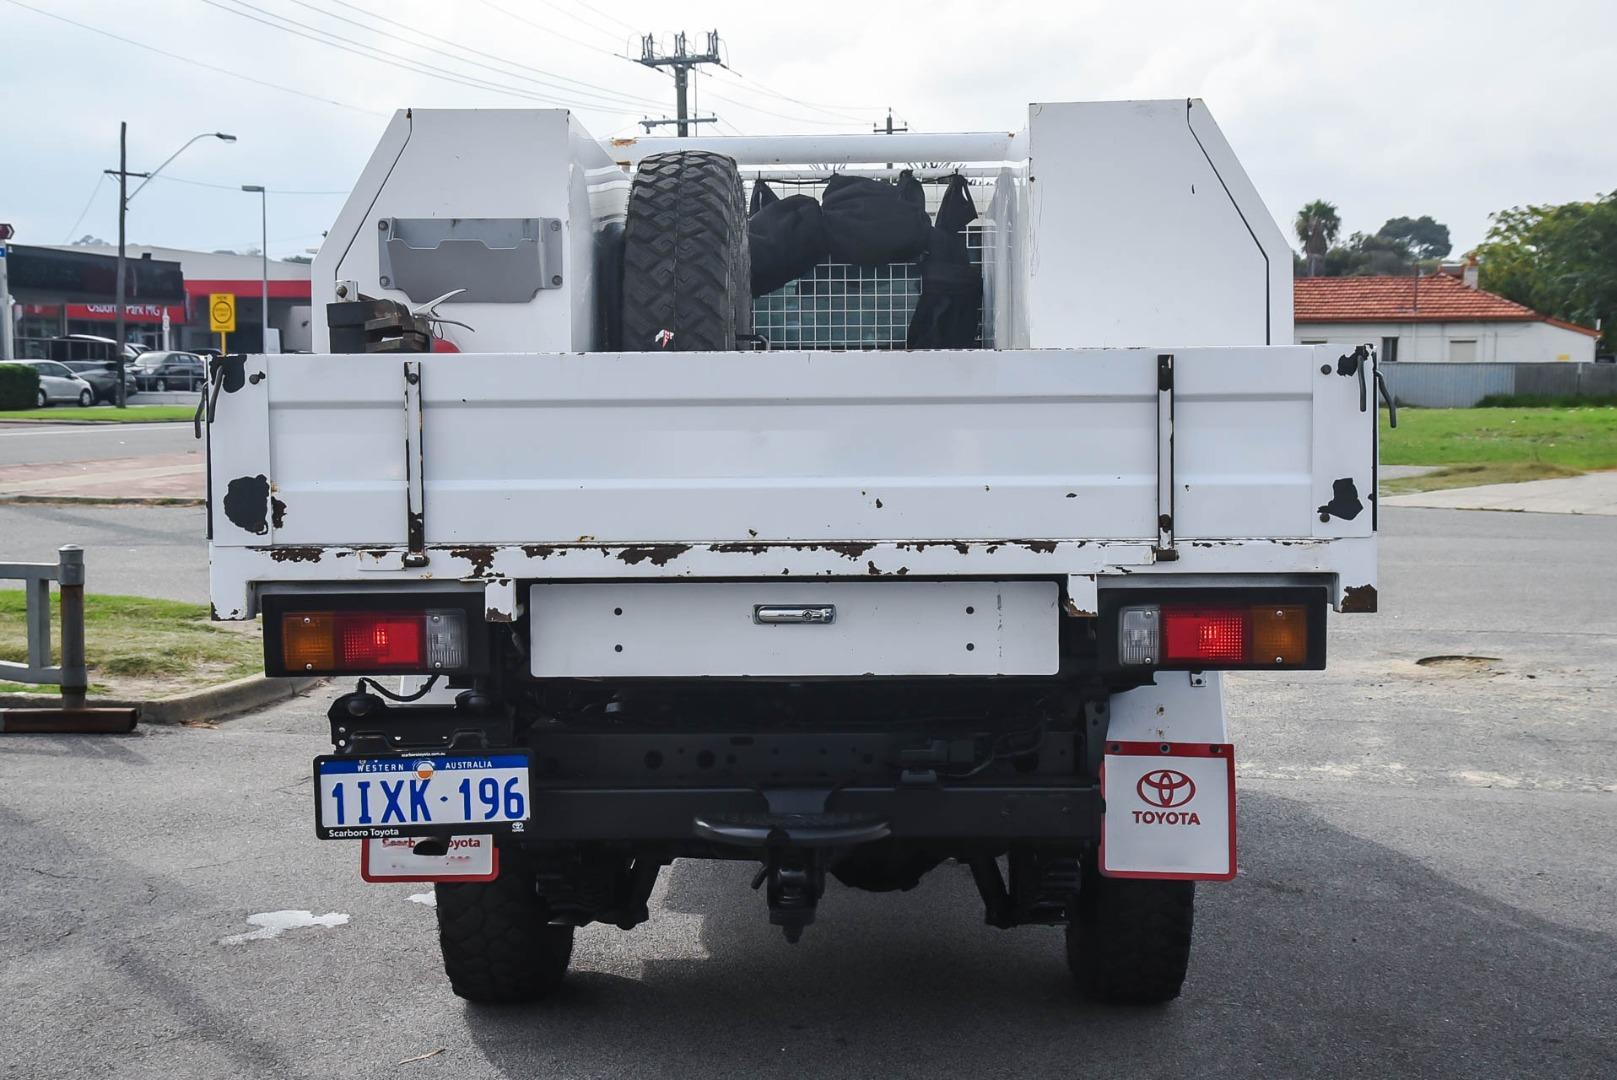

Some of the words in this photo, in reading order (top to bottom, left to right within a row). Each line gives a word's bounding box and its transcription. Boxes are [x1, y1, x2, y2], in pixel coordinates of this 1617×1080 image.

[87, 304, 117, 313] Osborn
[357, 764, 404, 772] WESTERN
[445, 761, 493, 769] AUSTRALIA
[1132, 811, 1201, 825] TOYOTA
[328, 829, 368, 838] Scarboro
[369, 828, 400, 838] Toyota
[448, 838, 481, 849] oyota
